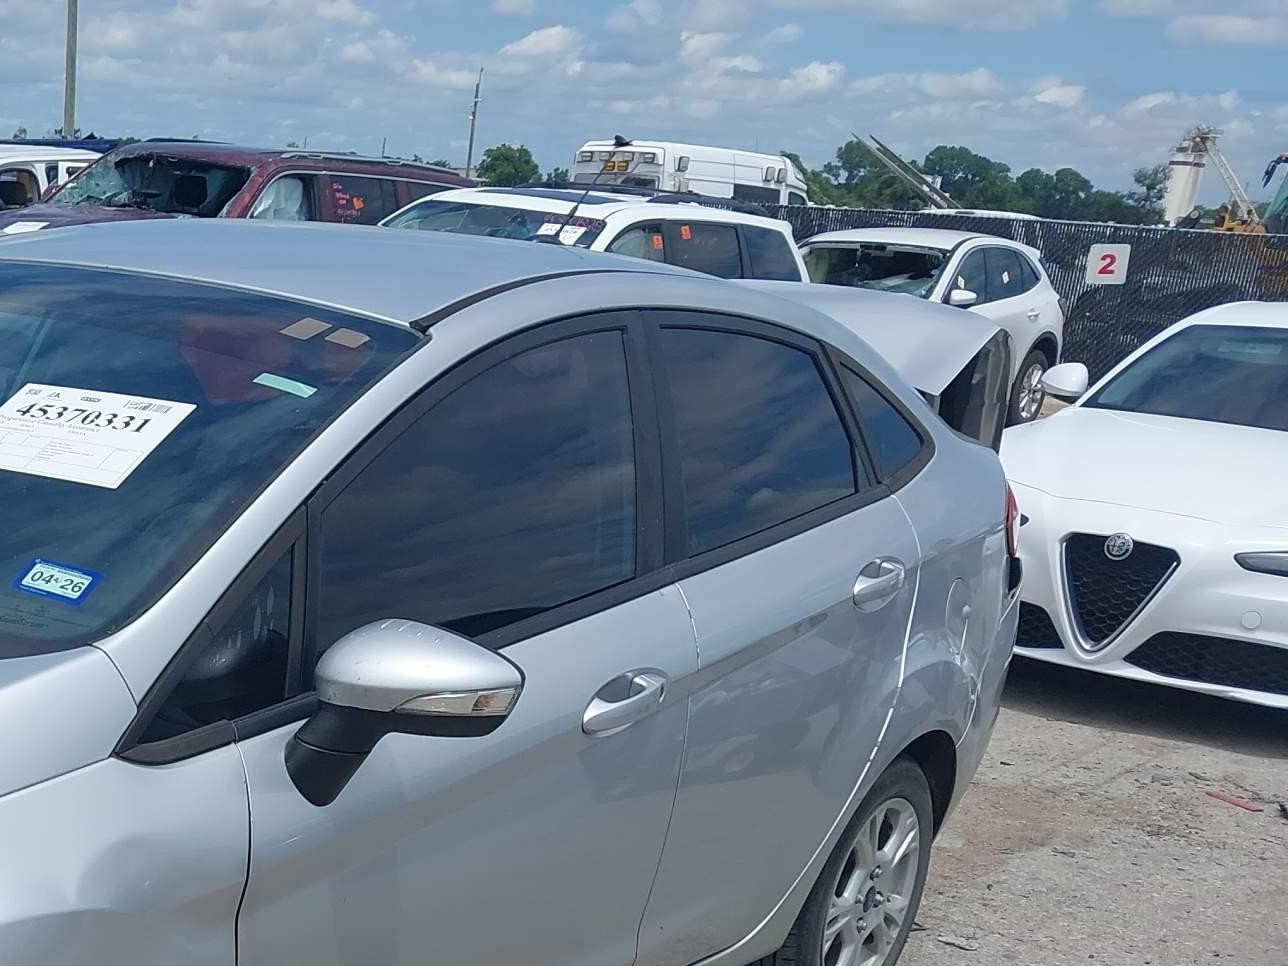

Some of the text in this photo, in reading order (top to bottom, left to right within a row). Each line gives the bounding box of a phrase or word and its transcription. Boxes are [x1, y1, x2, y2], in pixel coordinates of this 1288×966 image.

[1097, 253, 1116, 275] 2
[16, 402, 152, 433] 45370331
[30, 570, 55, 585] 04
[59, 578, 86, 594] 26
